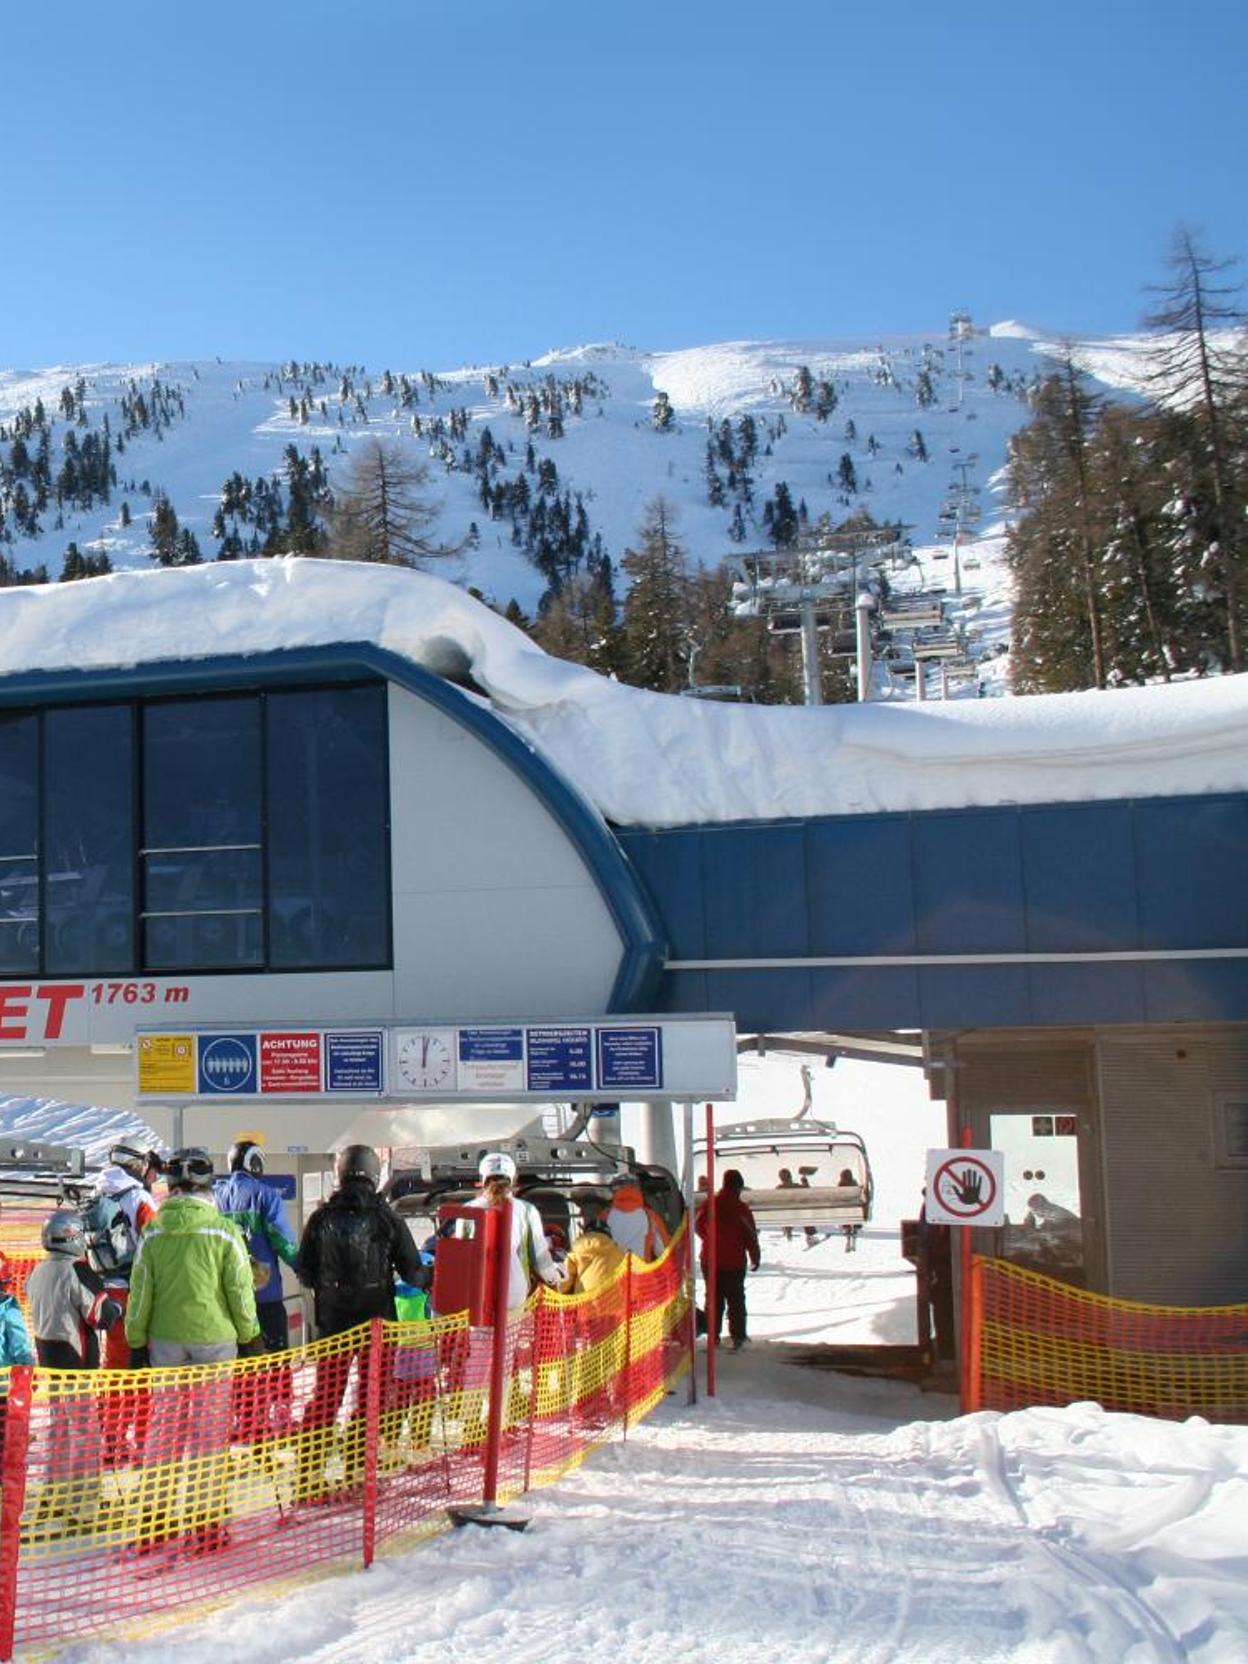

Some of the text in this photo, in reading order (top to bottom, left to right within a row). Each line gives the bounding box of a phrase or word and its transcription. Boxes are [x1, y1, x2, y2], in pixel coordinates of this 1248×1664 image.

[91, 983, 156, 1004] 1763
[164, 987, 189, 1003] m
[262, 1039, 318, 1050] ACHTUNG
